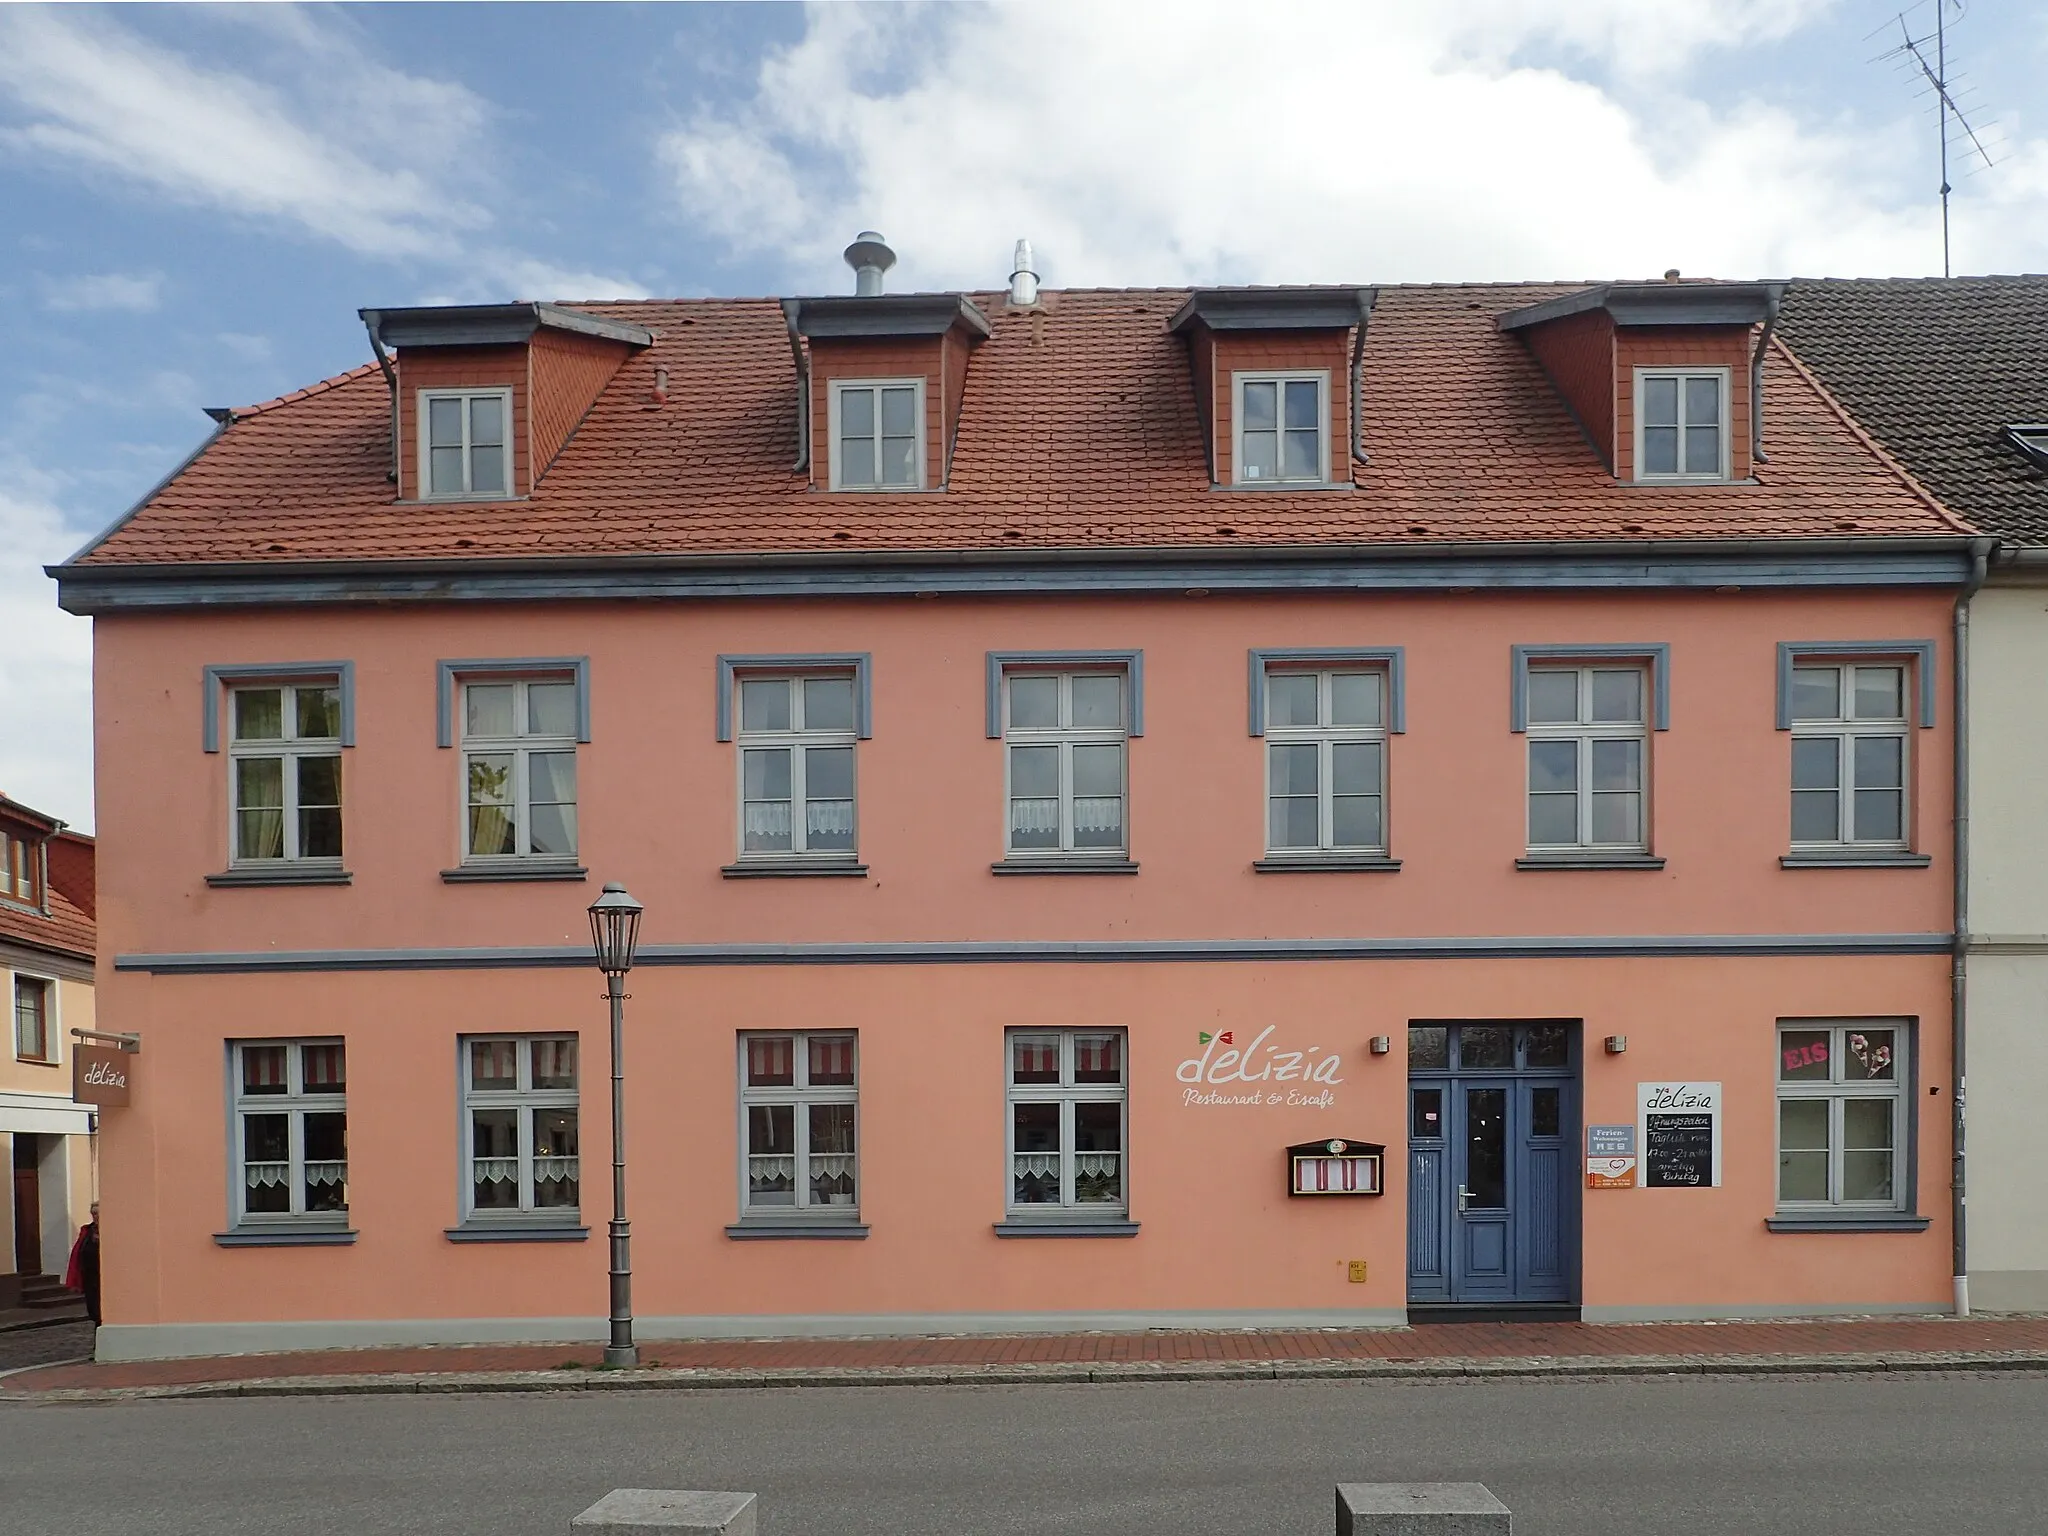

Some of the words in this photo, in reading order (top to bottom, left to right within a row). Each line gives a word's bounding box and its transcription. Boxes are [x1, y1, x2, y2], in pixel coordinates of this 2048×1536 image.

[1175, 1024, 1345, 1084] delizia
[1783, 1041, 1828, 1070] EIS
[84, 1062, 126, 1088] delizia
[1183, 1088, 1262, 1107] Restaurant
[1266, 1092, 1283, 1105] &
[1286, 1089, 1335, 1109] Eiscafé
[1646, 1085, 1712, 1109] delizia
